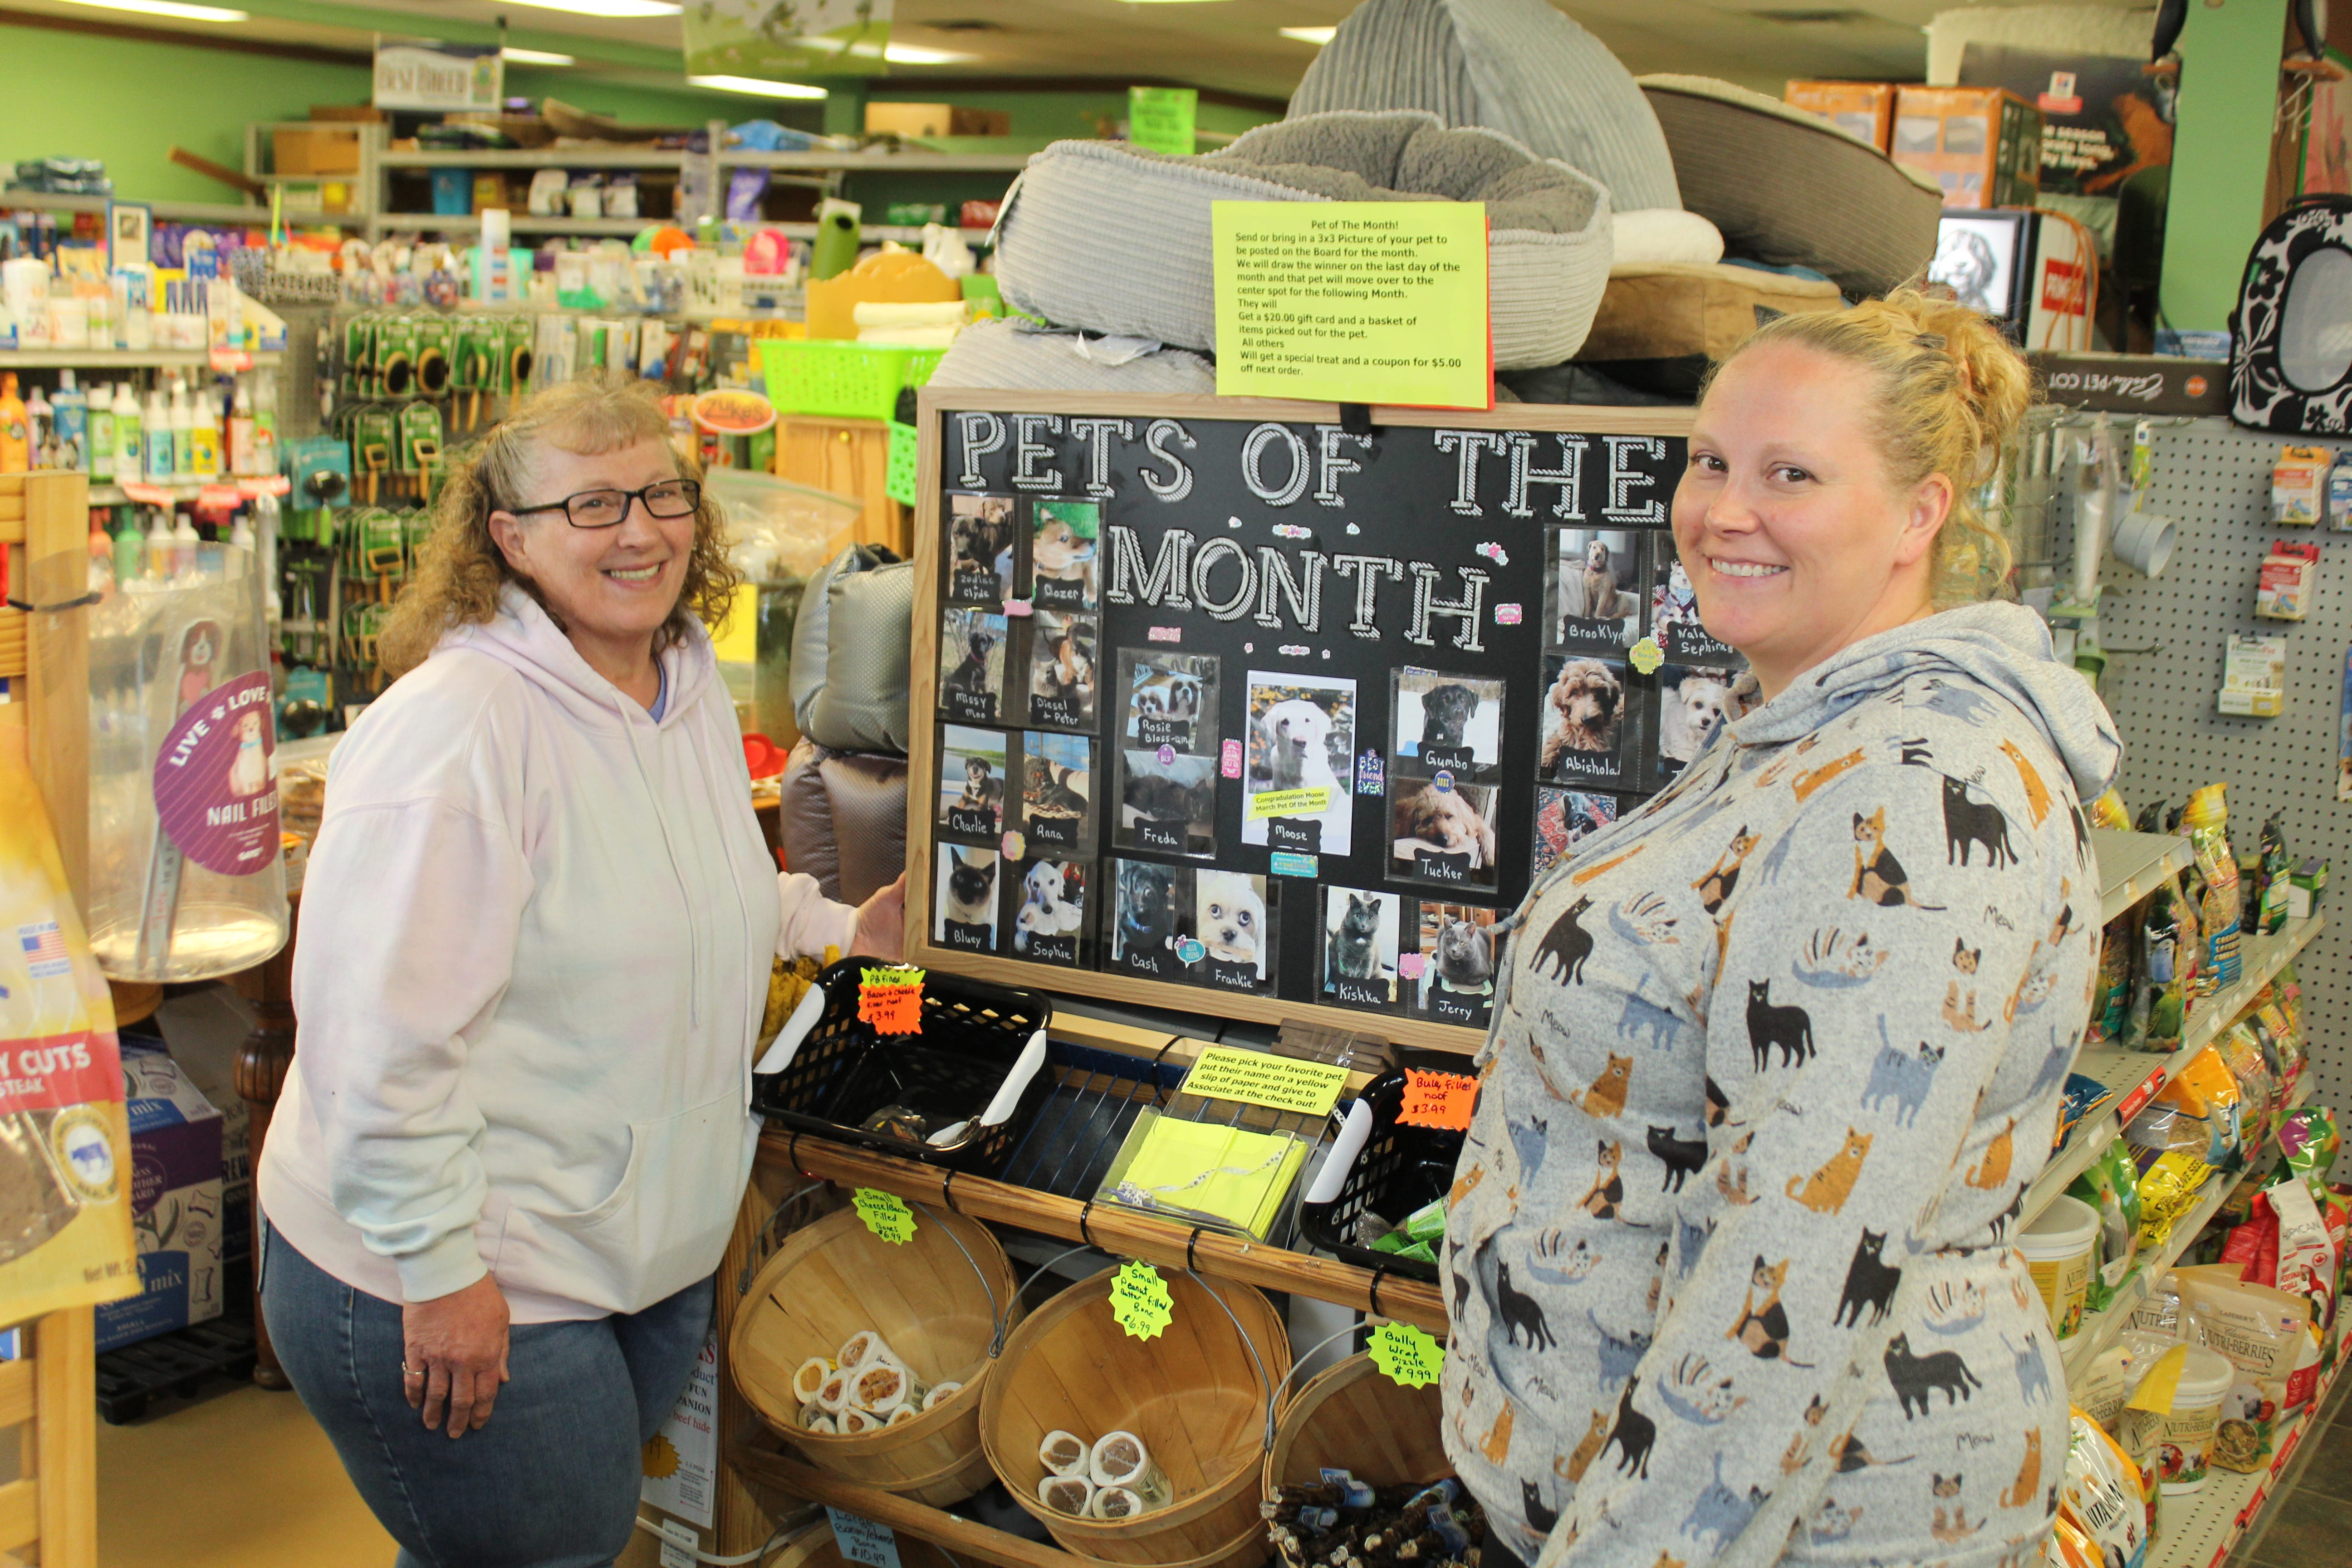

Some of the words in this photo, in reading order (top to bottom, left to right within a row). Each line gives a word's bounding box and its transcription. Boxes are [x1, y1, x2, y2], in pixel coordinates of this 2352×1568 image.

[1312, 220, 1326, 229] Pet
[1329, 220, 1338, 229] of
[1342, 220, 1359, 229] The
[1273, 233, 1295, 244] bring
[1319, 234, 1334, 242] 3x3
[1338, 235, 1373, 243] Picture
[1377, 235, 1386, 243] of
[1391, 237, 1412, 245] your
[1417, 235, 1433, 245] pet
[1272, 260, 1294, 269] draw
[1387, 262, 1404, 270] last
[1408, 262, 1426, 273] day
[1430, 262, 1440, 271] of
[1444, 263, 1460, 271] the
[1269, 288, 1286, 297] spot
[1290, 287, 1302, 295] for
[1323, 288, 1367, 299] following
[1372, 289, 1407, 298] Month.
[1239, 299, 1258, 309] They
[1264, 313, 1294, 322] $20.00
[1298, 314, 1312, 324] gift
[1316, 315, 1334, 323] card
[1338, 316, 1356, 324] and
[1369, 316, 1403, 325] basket
[1406, 317, 1416, 325] of
[1257, 339, 1284, 348] others
[1260, 353, 1274, 362] get
[1285, 355, 1313, 363] special
[1317, 355, 1338, 364] treat
[1343, 356, 1360, 364] and
[1414, 358, 1428, 366] for
[1432, 358, 1461, 368] $5.00
[1241, 364, 1252, 372] off
[1278, 367, 1303, 375] order.
[956, 411, 1197, 503] PETS
[1242, 422, 1372, 507] OF
[1434, 429, 1666, 523] THE
[964, 588, 990, 600] Clyde
[1044, 587, 1079, 601] Dozer
[1107, 525, 1490, 652] MONTH
[1678, 628, 1707, 639] Nala
[228, 686, 267, 710] LOVE
[956, 692, 987, 708] Missy
[1037, 697, 1067, 710] Diesel
[966, 708, 986, 719] Moo
[1055, 712, 1079, 725] Peter
[1142, 720, 1171, 732] Rosie
[169, 719, 211, 768] LIVE
[1426, 750, 1468, 770] Gumbo
[1256, 794, 1304, 803] Congradulation
[206, 804, 248, 827] NAIL
[952, 815, 987, 834] Charlie
[1037, 825, 1063, 840] Anna
[1275, 824, 1308, 841] Moose
[1144, 828, 1178, 845] Freda
[954, 928, 981, 948] Bluey
[1033, 941, 1072, 960] Sophie
[1132, 953, 1159, 973] Cash
[1215, 969, 1254, 989] Frankie
[1339, 983, 1381, 1004] Kishka
[1439, 1000, 1472, 1020] Jerry
[1541, 1009, 1571, 1039] Meow
[20, 1042, 92, 1076] CUTS
[1206, 1053, 1236, 1063] Please
[1285, 1064, 1323, 1077] favorite
[1325, 1073, 1343, 1082] pet,
[1244, 1071, 1270, 1079] name
[1296, 1079, 1328, 1088] yellow
[1416, 1077, 1441, 1091] Bully
[1187, 1082, 1232, 1093] Associate
[1265, 1094, 1293, 1104] check
[864, 1191, 893, 1203] Small
[873, 1210, 897, 1221] Filled
[876, 1222, 898, 1232] Bones
[1121, 1276, 1148, 1296] Peanut
[1132, 1269, 1158, 1287] Small
[1134, 1302, 1154, 1319] Bone
[1385, 1331, 1416, 1351] Bully
[1389, 1344, 1419, 1360] Wrap
[689, 1382, 708, 1398] FUN
[673, 1409, 691, 1426] beef
[693, 1413, 711, 1434] hide
